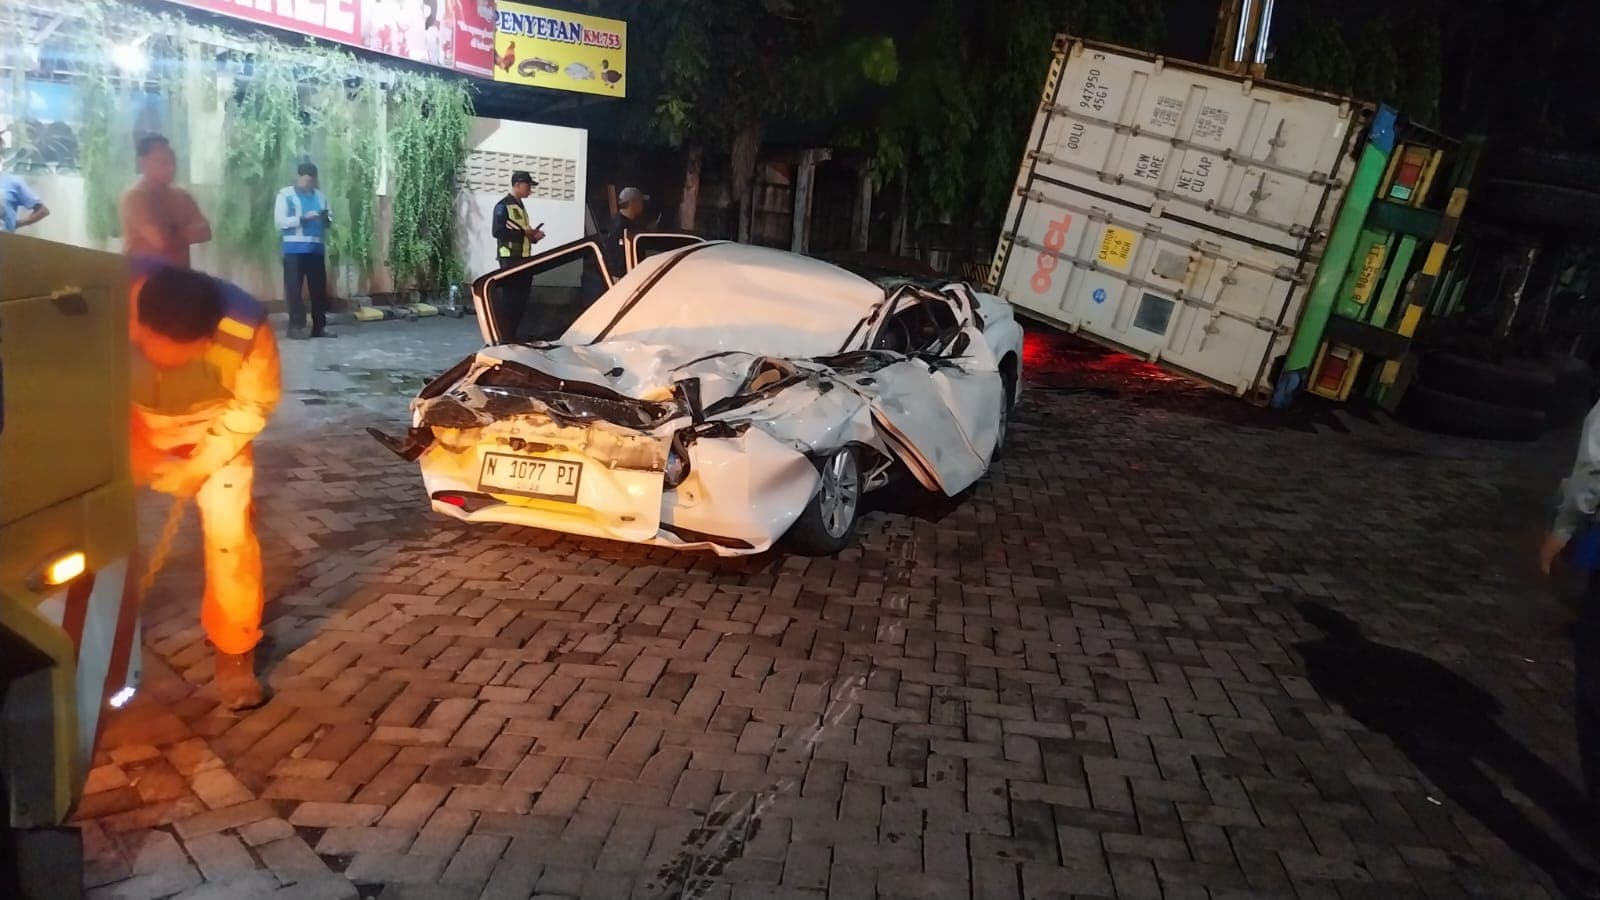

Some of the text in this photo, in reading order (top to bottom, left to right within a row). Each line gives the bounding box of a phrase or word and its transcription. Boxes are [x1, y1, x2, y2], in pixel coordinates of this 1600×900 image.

[1080, 69, 1101, 108] 947950
[1134, 153, 1151, 178] MGW
[1146, 155, 1165, 179] TARE
[1176, 169, 1195, 190] NET
[1191, 156, 1212, 193] CU CAP
[1030, 214, 1072, 294] OOCL
[1098, 229, 1115, 260] CAUTION
[1119, 241, 1132, 260] HIGH
[487, 458, 575, 486] N 1077 PI
